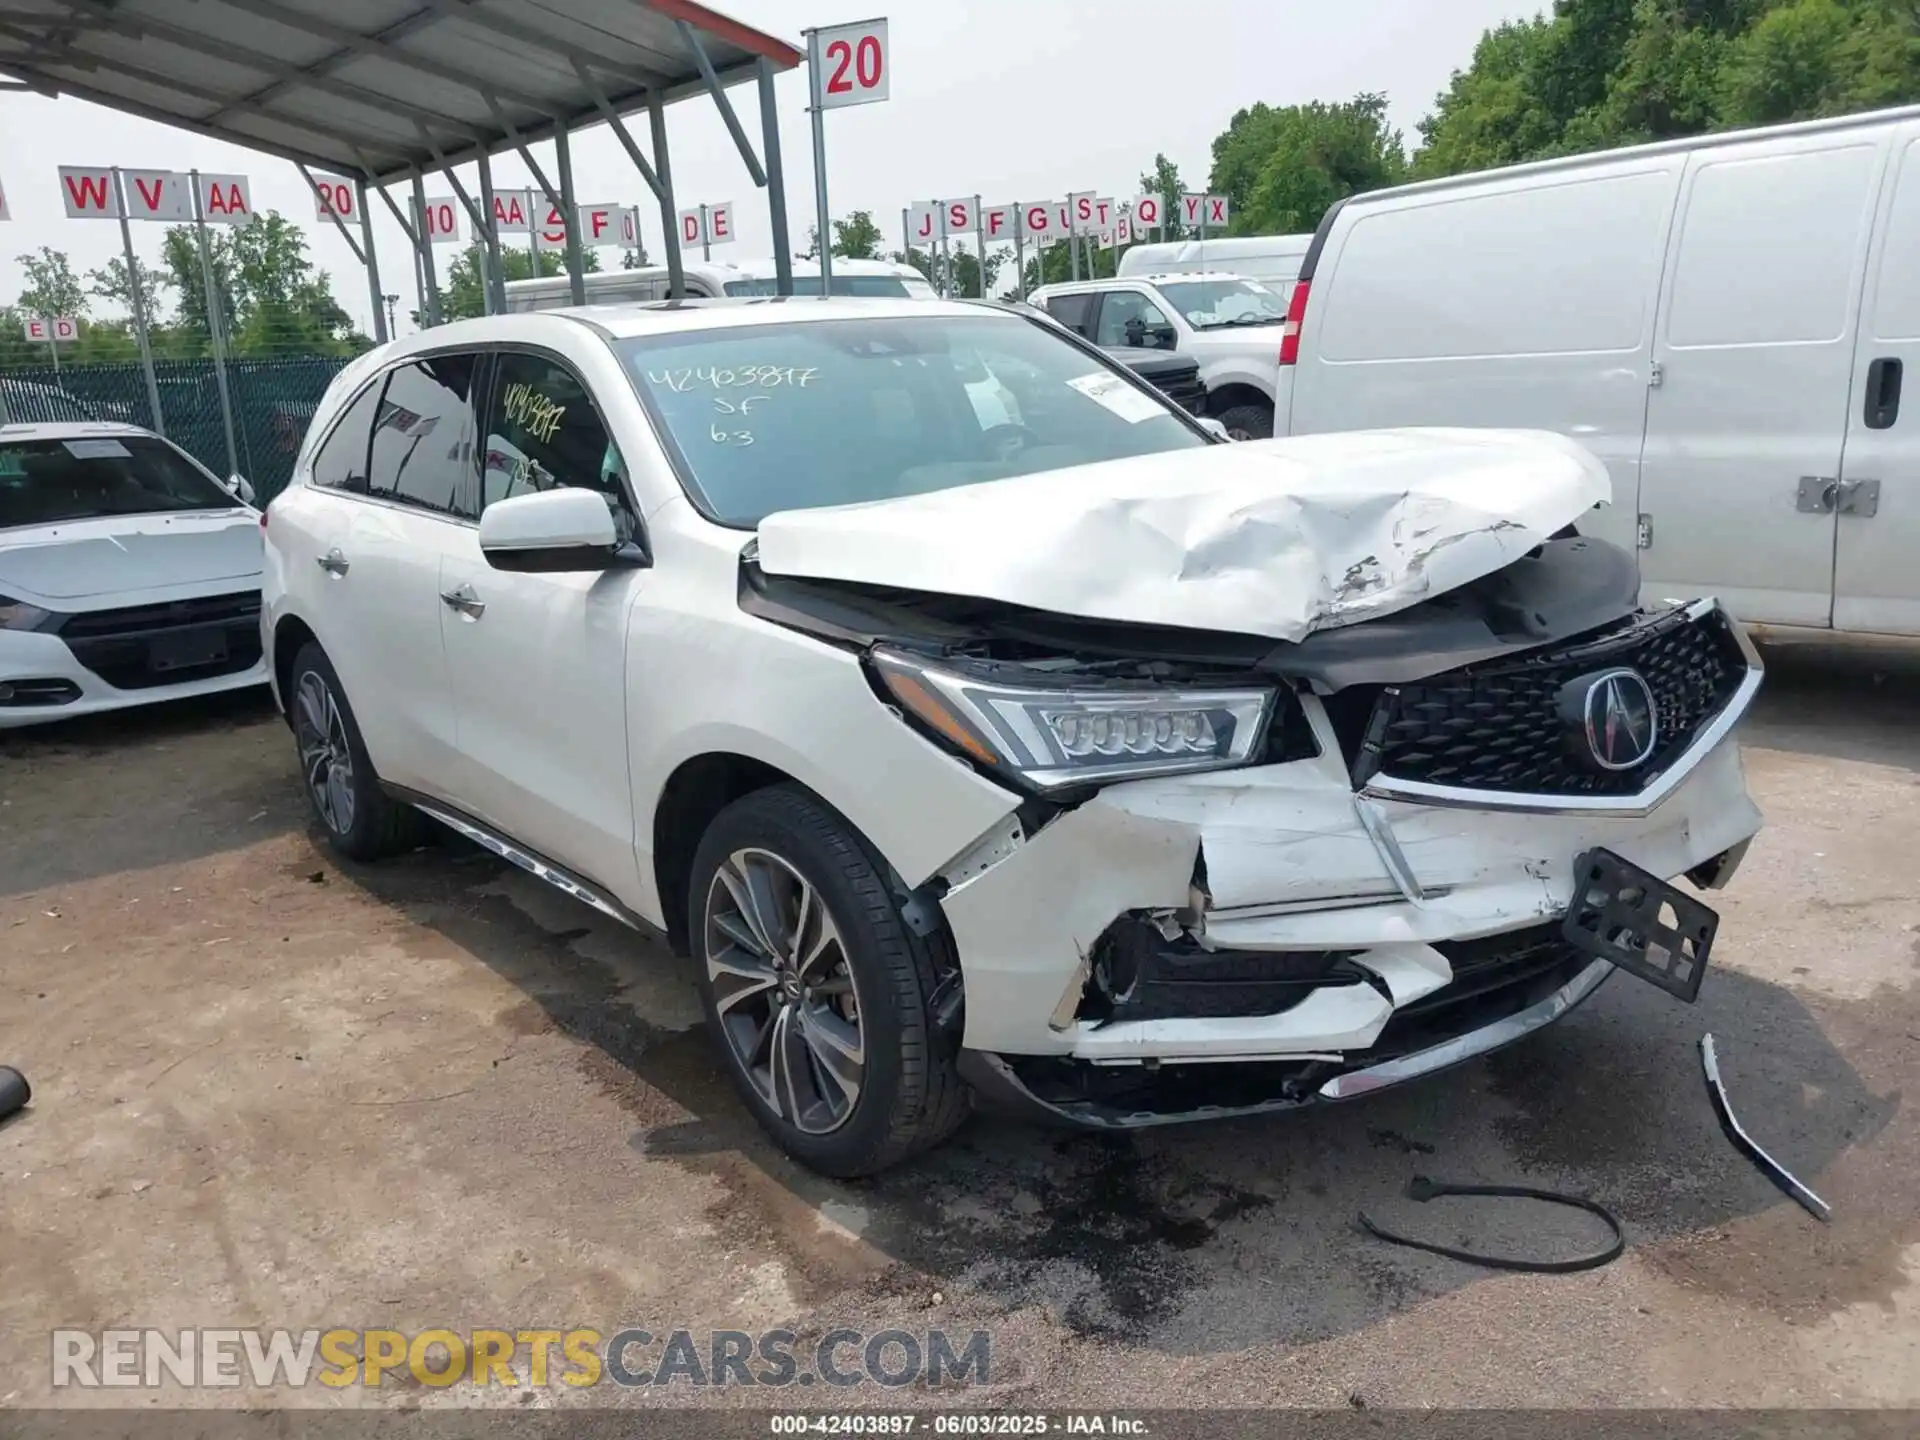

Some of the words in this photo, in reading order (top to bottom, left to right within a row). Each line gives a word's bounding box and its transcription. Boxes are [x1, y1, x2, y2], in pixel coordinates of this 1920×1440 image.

[826, 35, 882, 94] 20
[65, 176, 108, 210] W
[136, 178, 163, 211] V
[208, 183, 247, 215] AA
[319, 183, 353, 215] 20
[494, 197, 525, 225] AA
[950, 204, 968, 227] S
[1028, 207, 1048, 231] G
[1078, 198, 1091, 220] S
[1096, 203, 1109, 225] T
[1139, 200, 1157, 222] Q
[1186, 199, 1199, 220] Y
[1211, 200, 1224, 221] X
[591, 211, 609, 238] F
[685, 216, 698, 241] D
[714, 210, 728, 237] E
[918, 213, 931, 237] J
[990, 211, 1005, 235] F
[1118, 218, 1128, 239] B
[29, 322, 44, 338] E
[57, 322, 72, 337] D
[648, 364, 823, 393] 42403897
